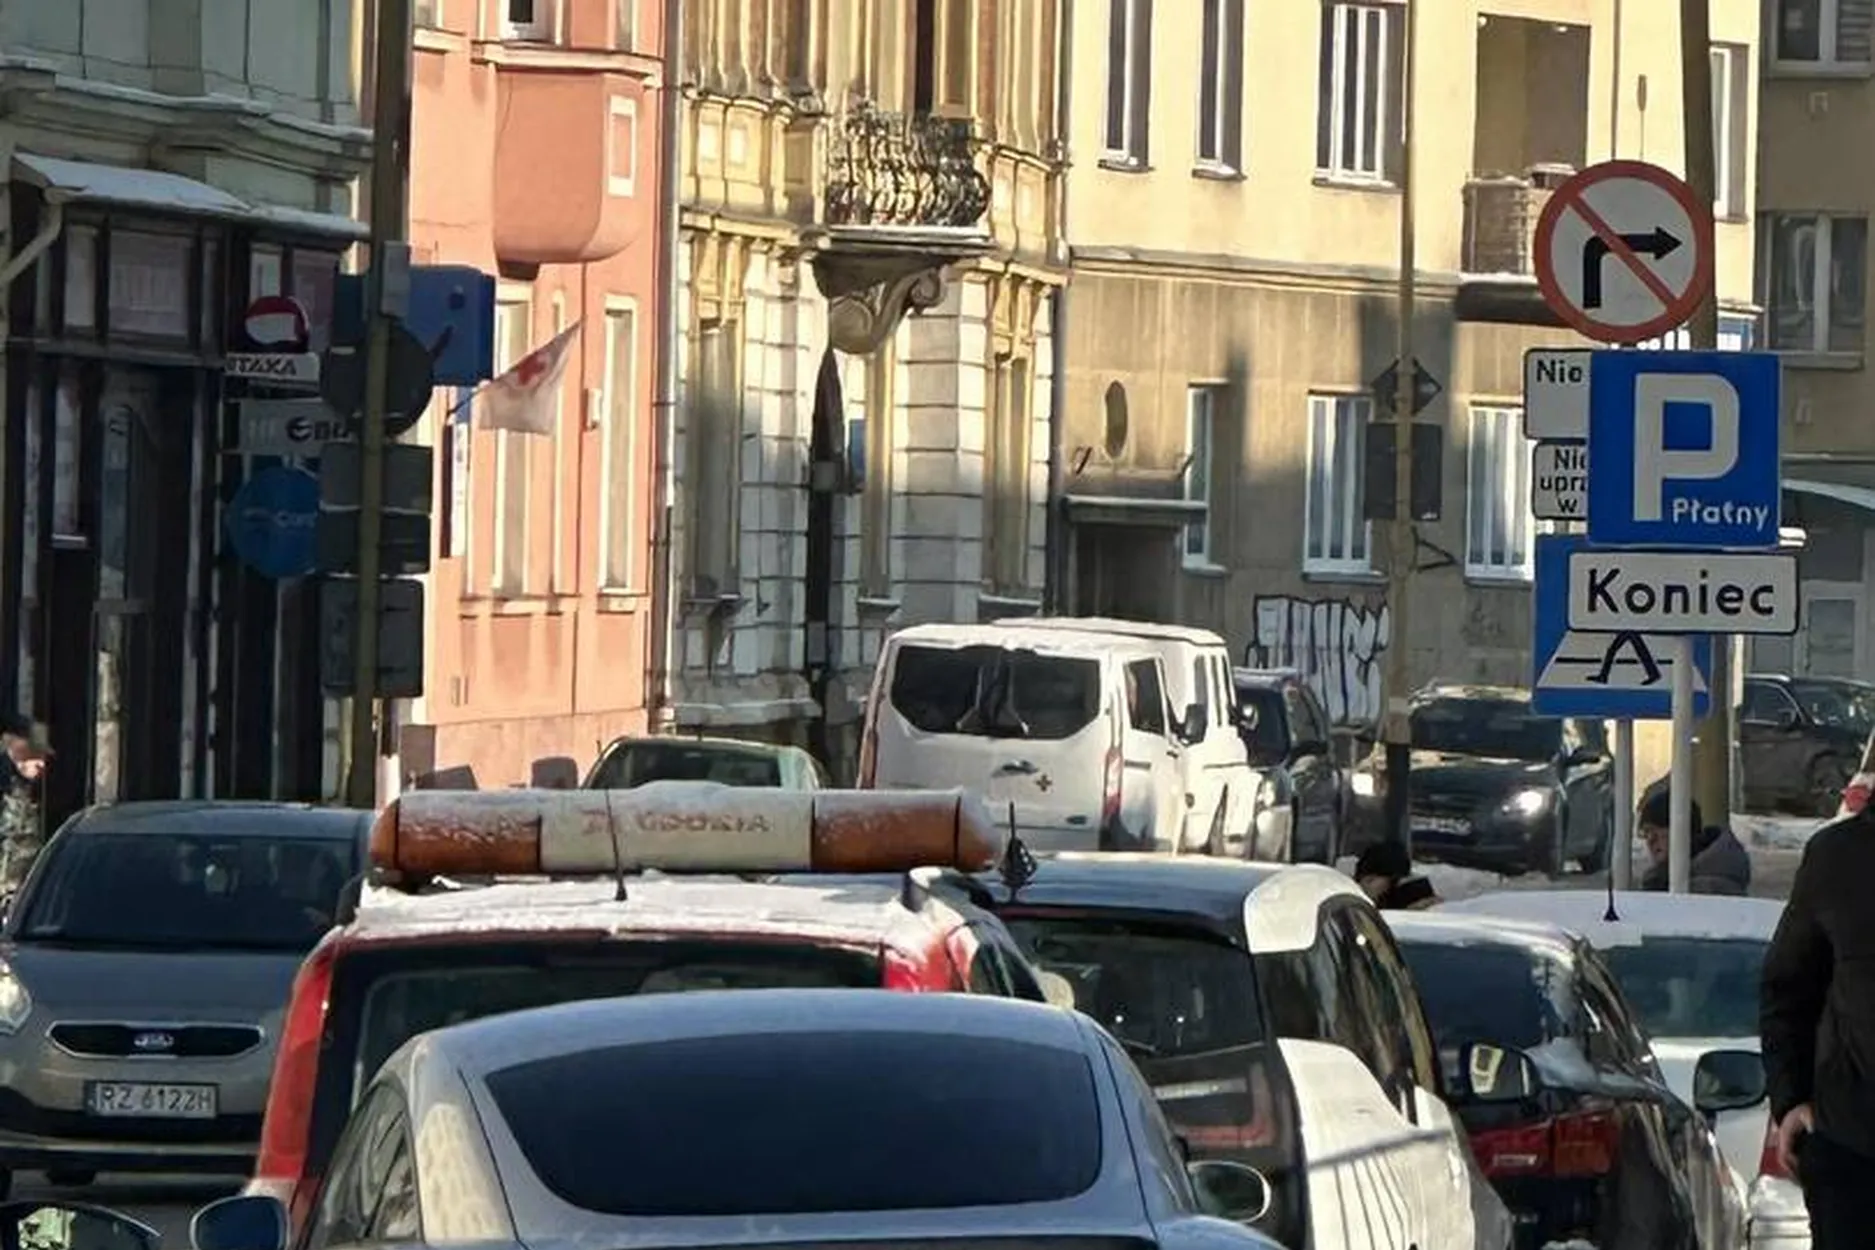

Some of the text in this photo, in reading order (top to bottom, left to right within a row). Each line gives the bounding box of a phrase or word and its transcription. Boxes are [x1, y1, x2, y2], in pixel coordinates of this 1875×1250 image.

[1633, 373, 1740, 521] P
[1672, 498, 1768, 531] Płatny
[1587, 568, 1775, 615] Koniec
[101, 1086, 133, 1110] RZ
